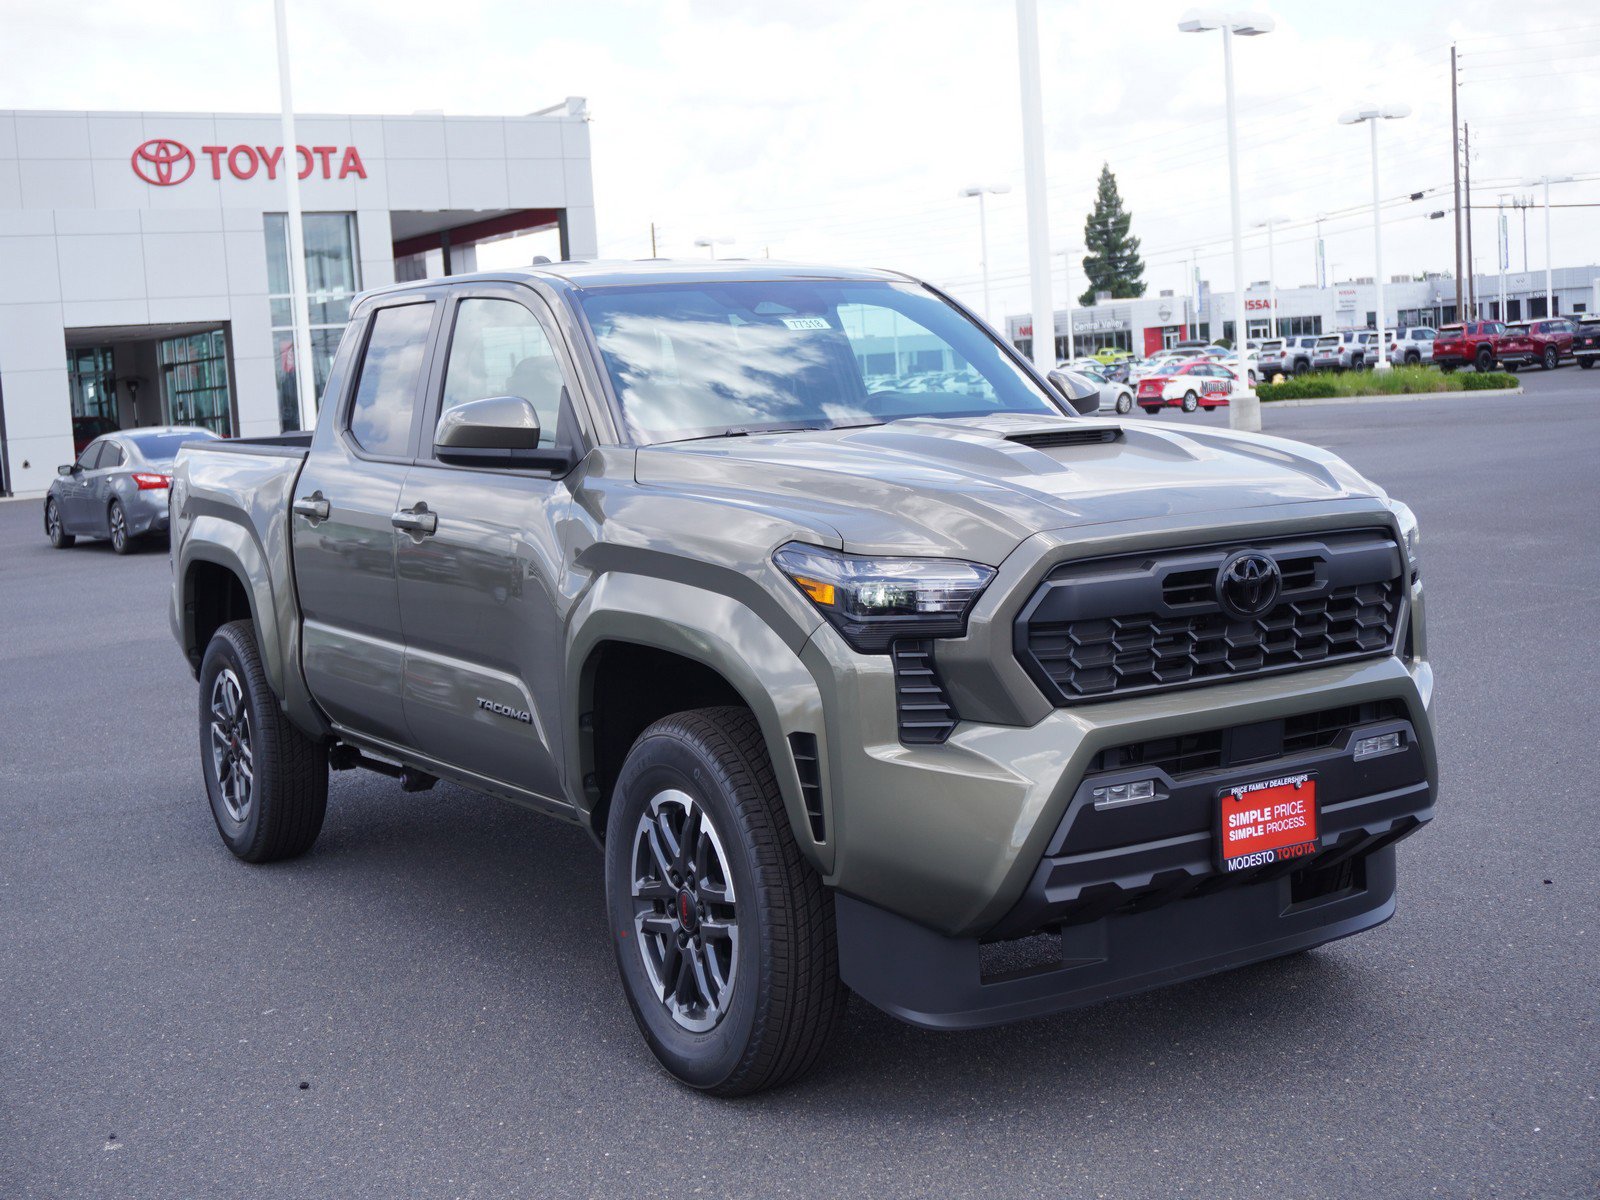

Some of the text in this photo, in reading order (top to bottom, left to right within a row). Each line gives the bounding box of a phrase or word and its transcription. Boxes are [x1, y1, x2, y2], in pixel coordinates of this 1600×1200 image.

[201, 144, 368, 180] TOYOTA
[789, 319, 824, 329] 77318
[1073, 319, 1124, 331] Central Valley
[476, 696, 531, 722] TACOMA
[1231, 774, 1309, 796] PRICE FAMILY DEALERSHIPS
[1228, 800, 1307, 828] SIMPLE PRICE.
[1229, 816, 1307, 842] SIMPLE PROCESS.
[1228, 843, 1316, 872] MODESTO TOYOTA
